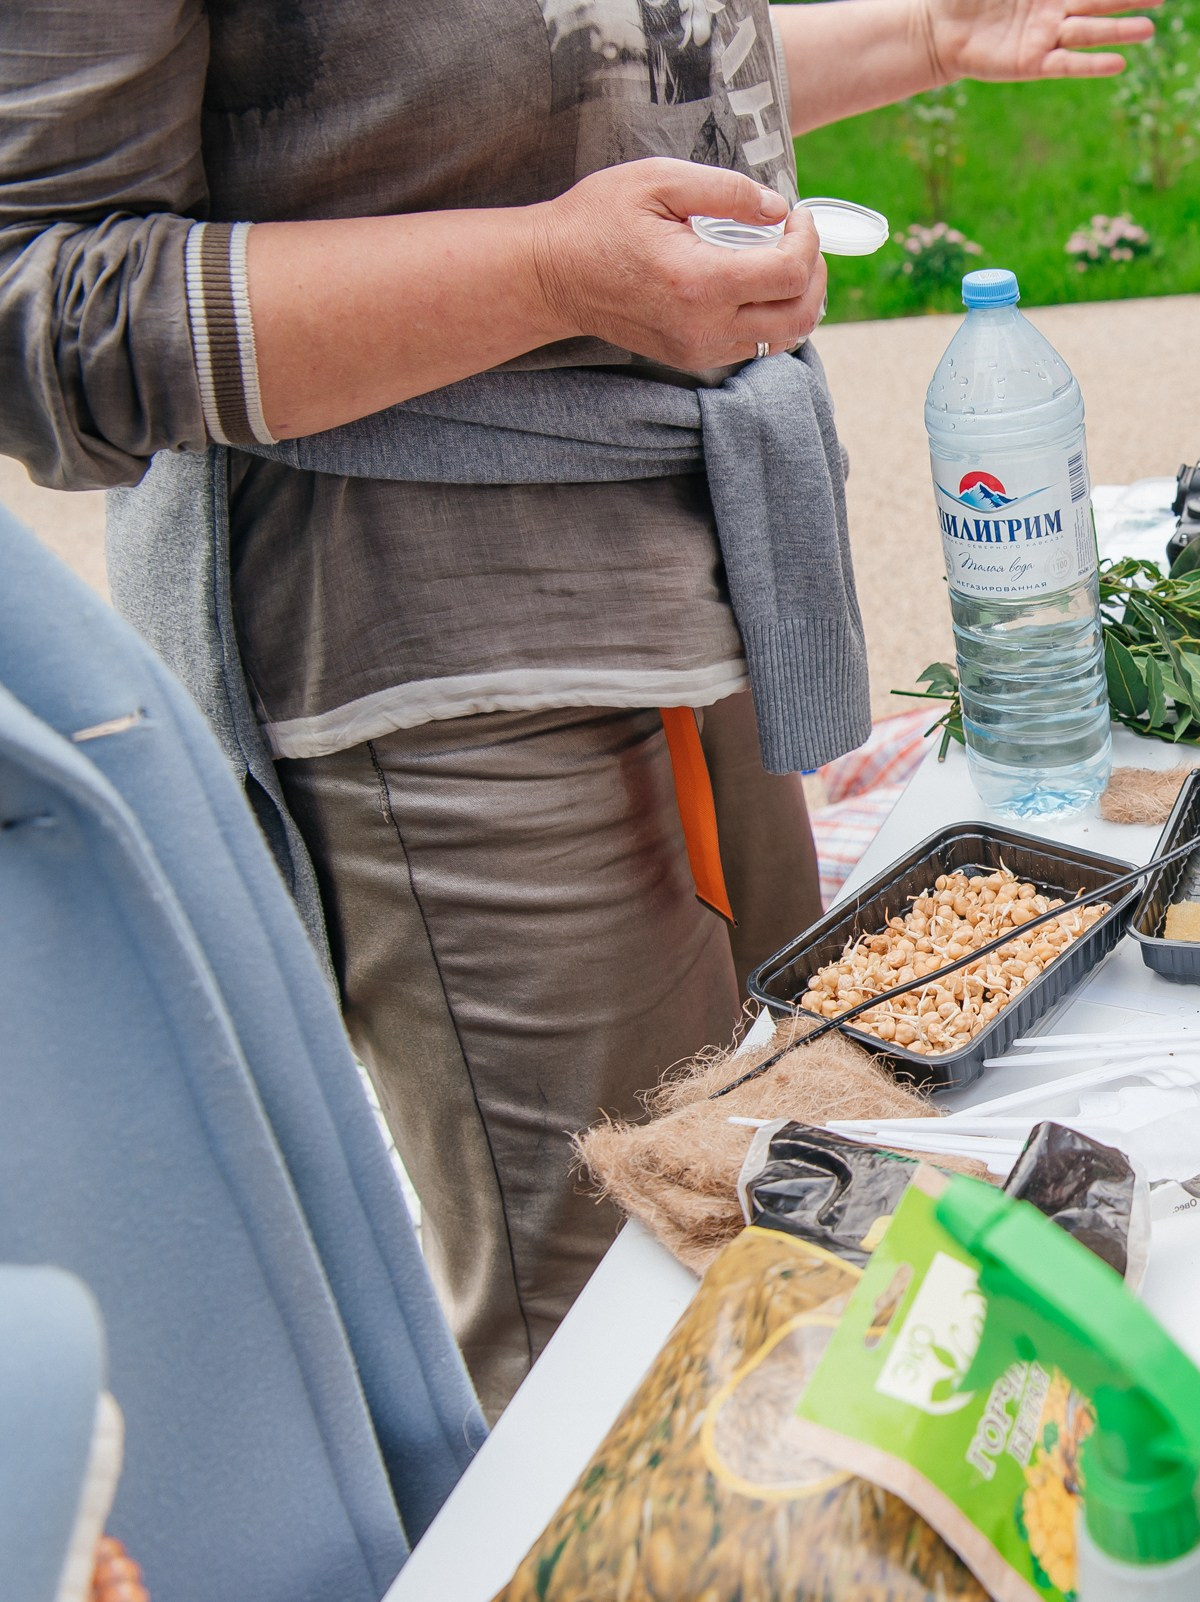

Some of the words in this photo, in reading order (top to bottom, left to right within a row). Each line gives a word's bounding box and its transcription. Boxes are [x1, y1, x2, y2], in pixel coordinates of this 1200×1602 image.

[958, 551, 1005, 573] Талая
[1008, 556, 1034, 582] вода
[956, 579, 1047, 592] НЕГАЗИРОВАННАЯ
